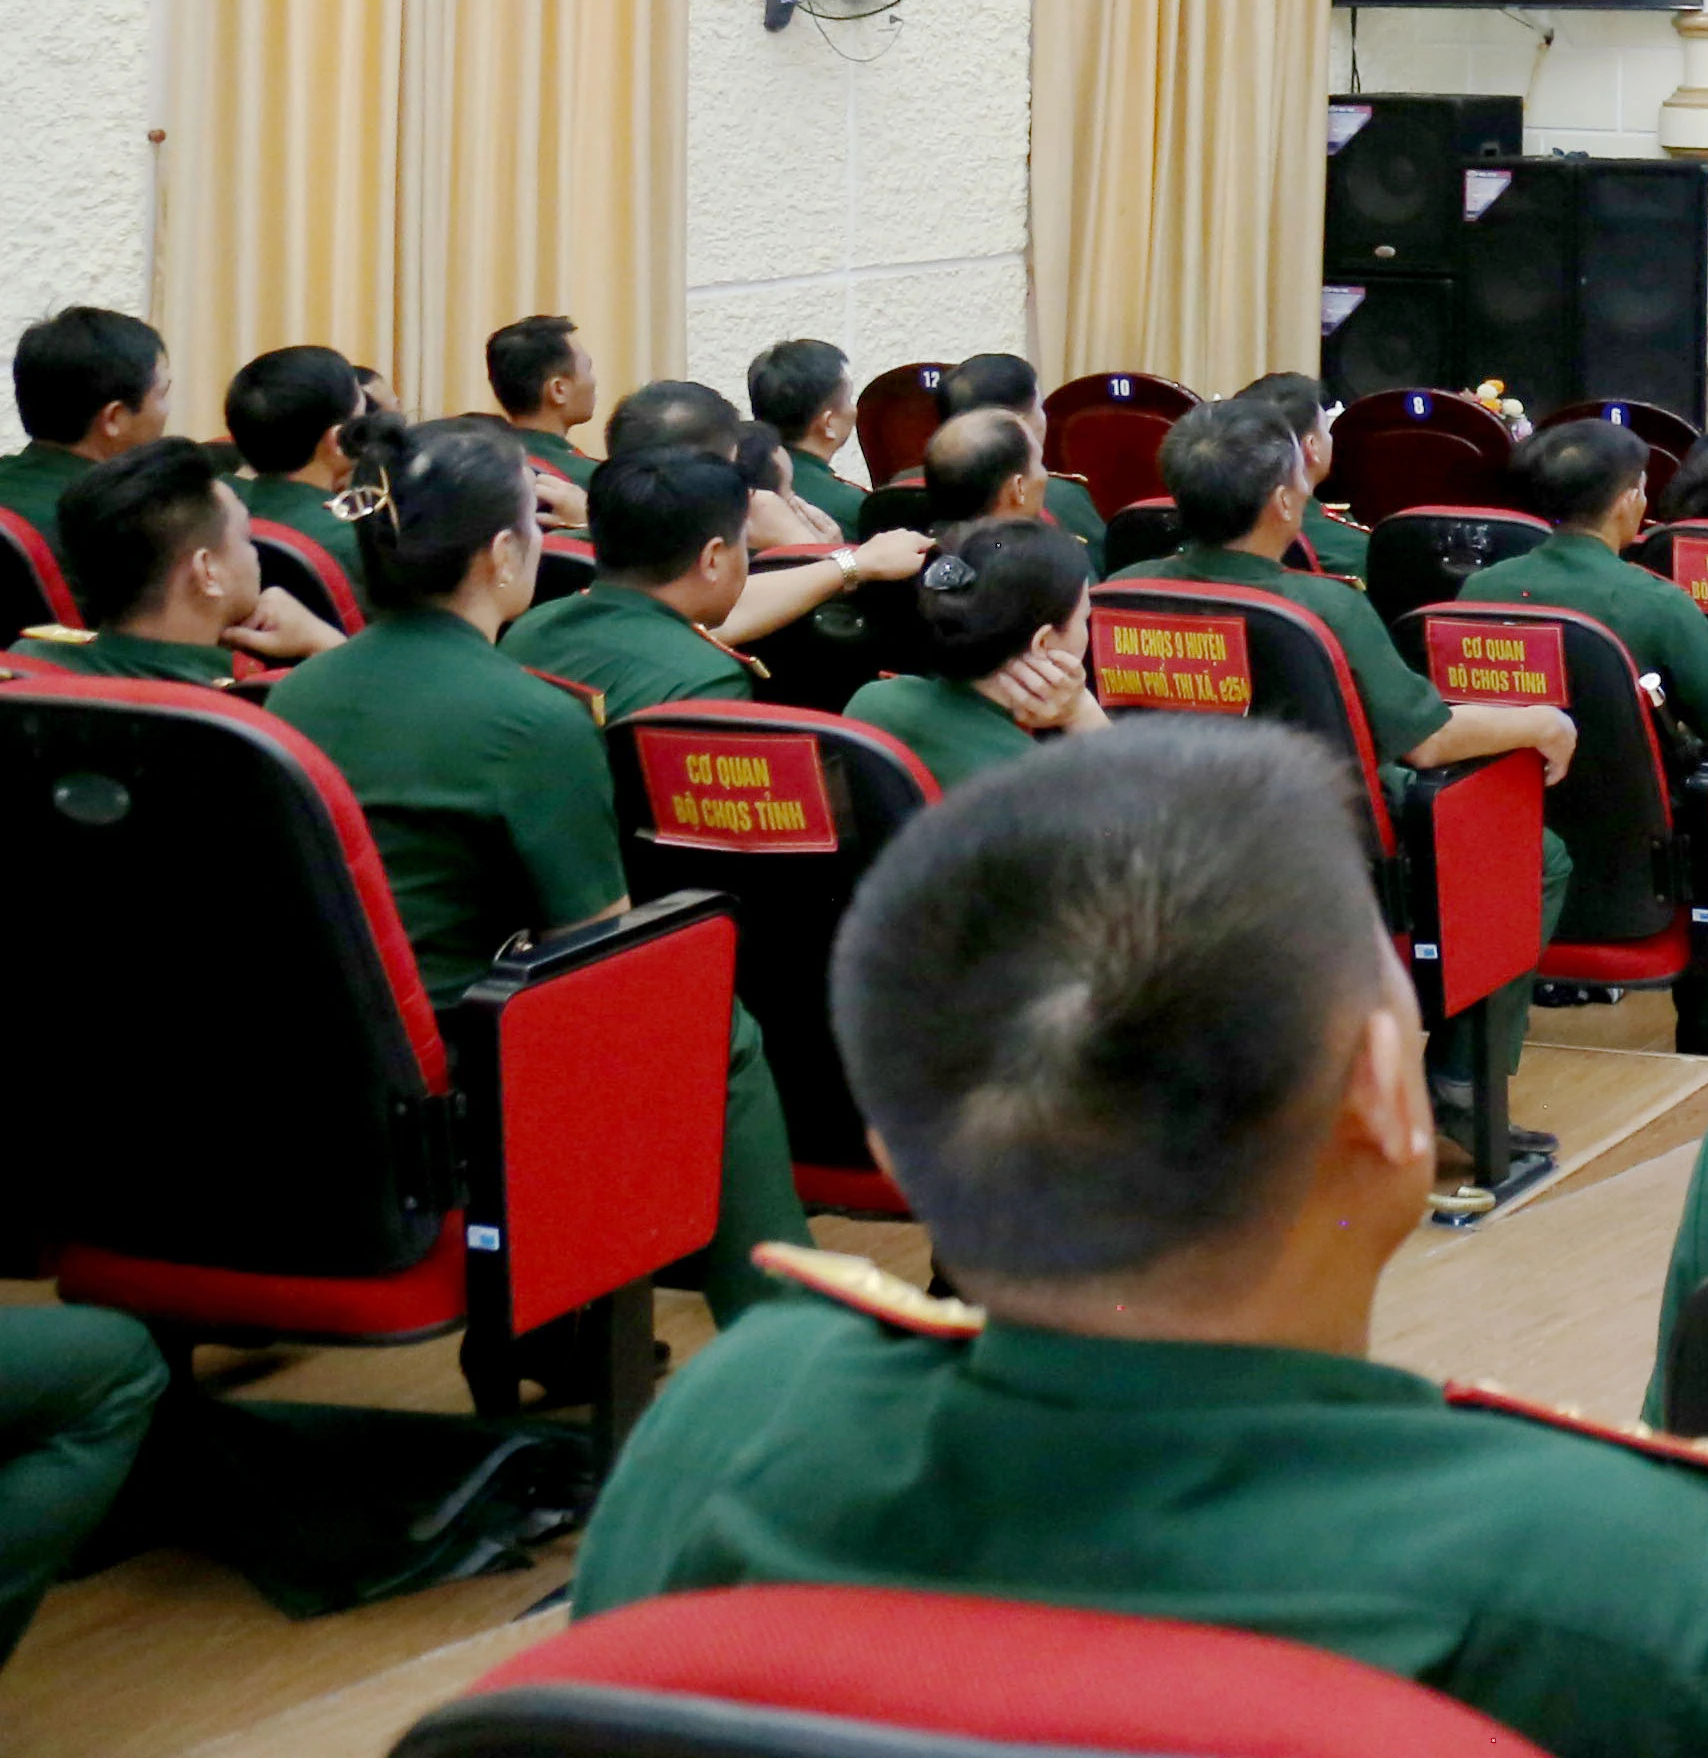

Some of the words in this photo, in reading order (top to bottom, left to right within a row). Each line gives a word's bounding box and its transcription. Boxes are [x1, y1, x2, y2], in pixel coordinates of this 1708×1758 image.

[1111, 379, 1130, 396] 10
[1414, 397, 1424, 414] 8
[1611, 408, 1621, 425] 6
[1114, 626, 1139, 655] BAN
[1175, 632, 1183, 658] 9
[1186, 628, 1226, 666] HUYỆN
[1462, 636, 1482, 658] CƠ
[1486, 639, 1525, 662] QUAN
[1448, 663, 1468, 692] BỘ
[1512, 664, 1546, 694] TỈNH
[686, 753, 712, 785] CƠ
[716, 756, 770, 789] QUAN
[755, 792, 806, 830] TỈNH
